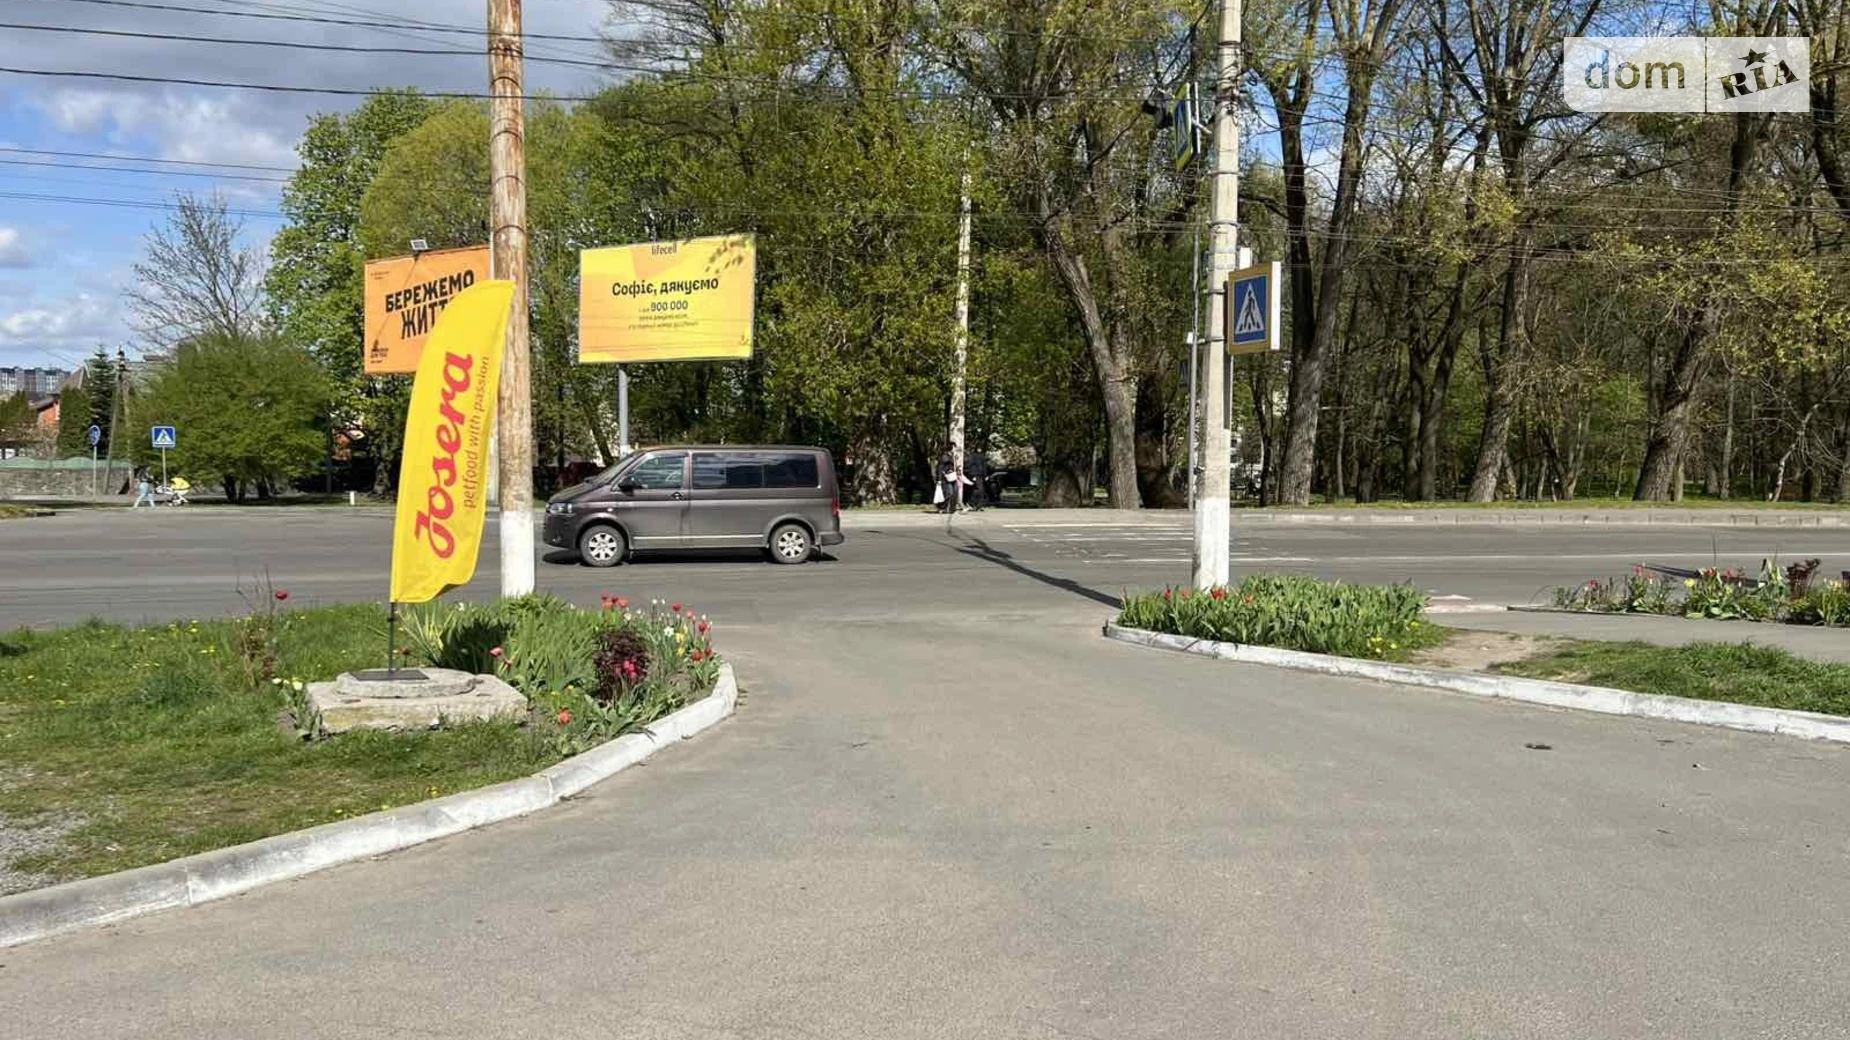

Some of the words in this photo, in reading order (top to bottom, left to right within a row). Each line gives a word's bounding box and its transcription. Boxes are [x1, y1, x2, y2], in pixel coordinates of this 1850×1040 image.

[651, 244, 677, 255] lifecell
[385, 269, 475, 313] БЕРЕЖЕМО
[612, 280, 657, 298] Софіє,
[660, 278, 719, 295] дякуємо
[651, 301, 668, 312] 900
[670, 300, 688, 310] 000
[401, 296, 455, 340] ЖИТТ
[474, 356, 490, 414] passion
[470, 414, 482, 447] with
[414, 352, 474, 559] Josera
[463, 448, 479, 509] petfood
